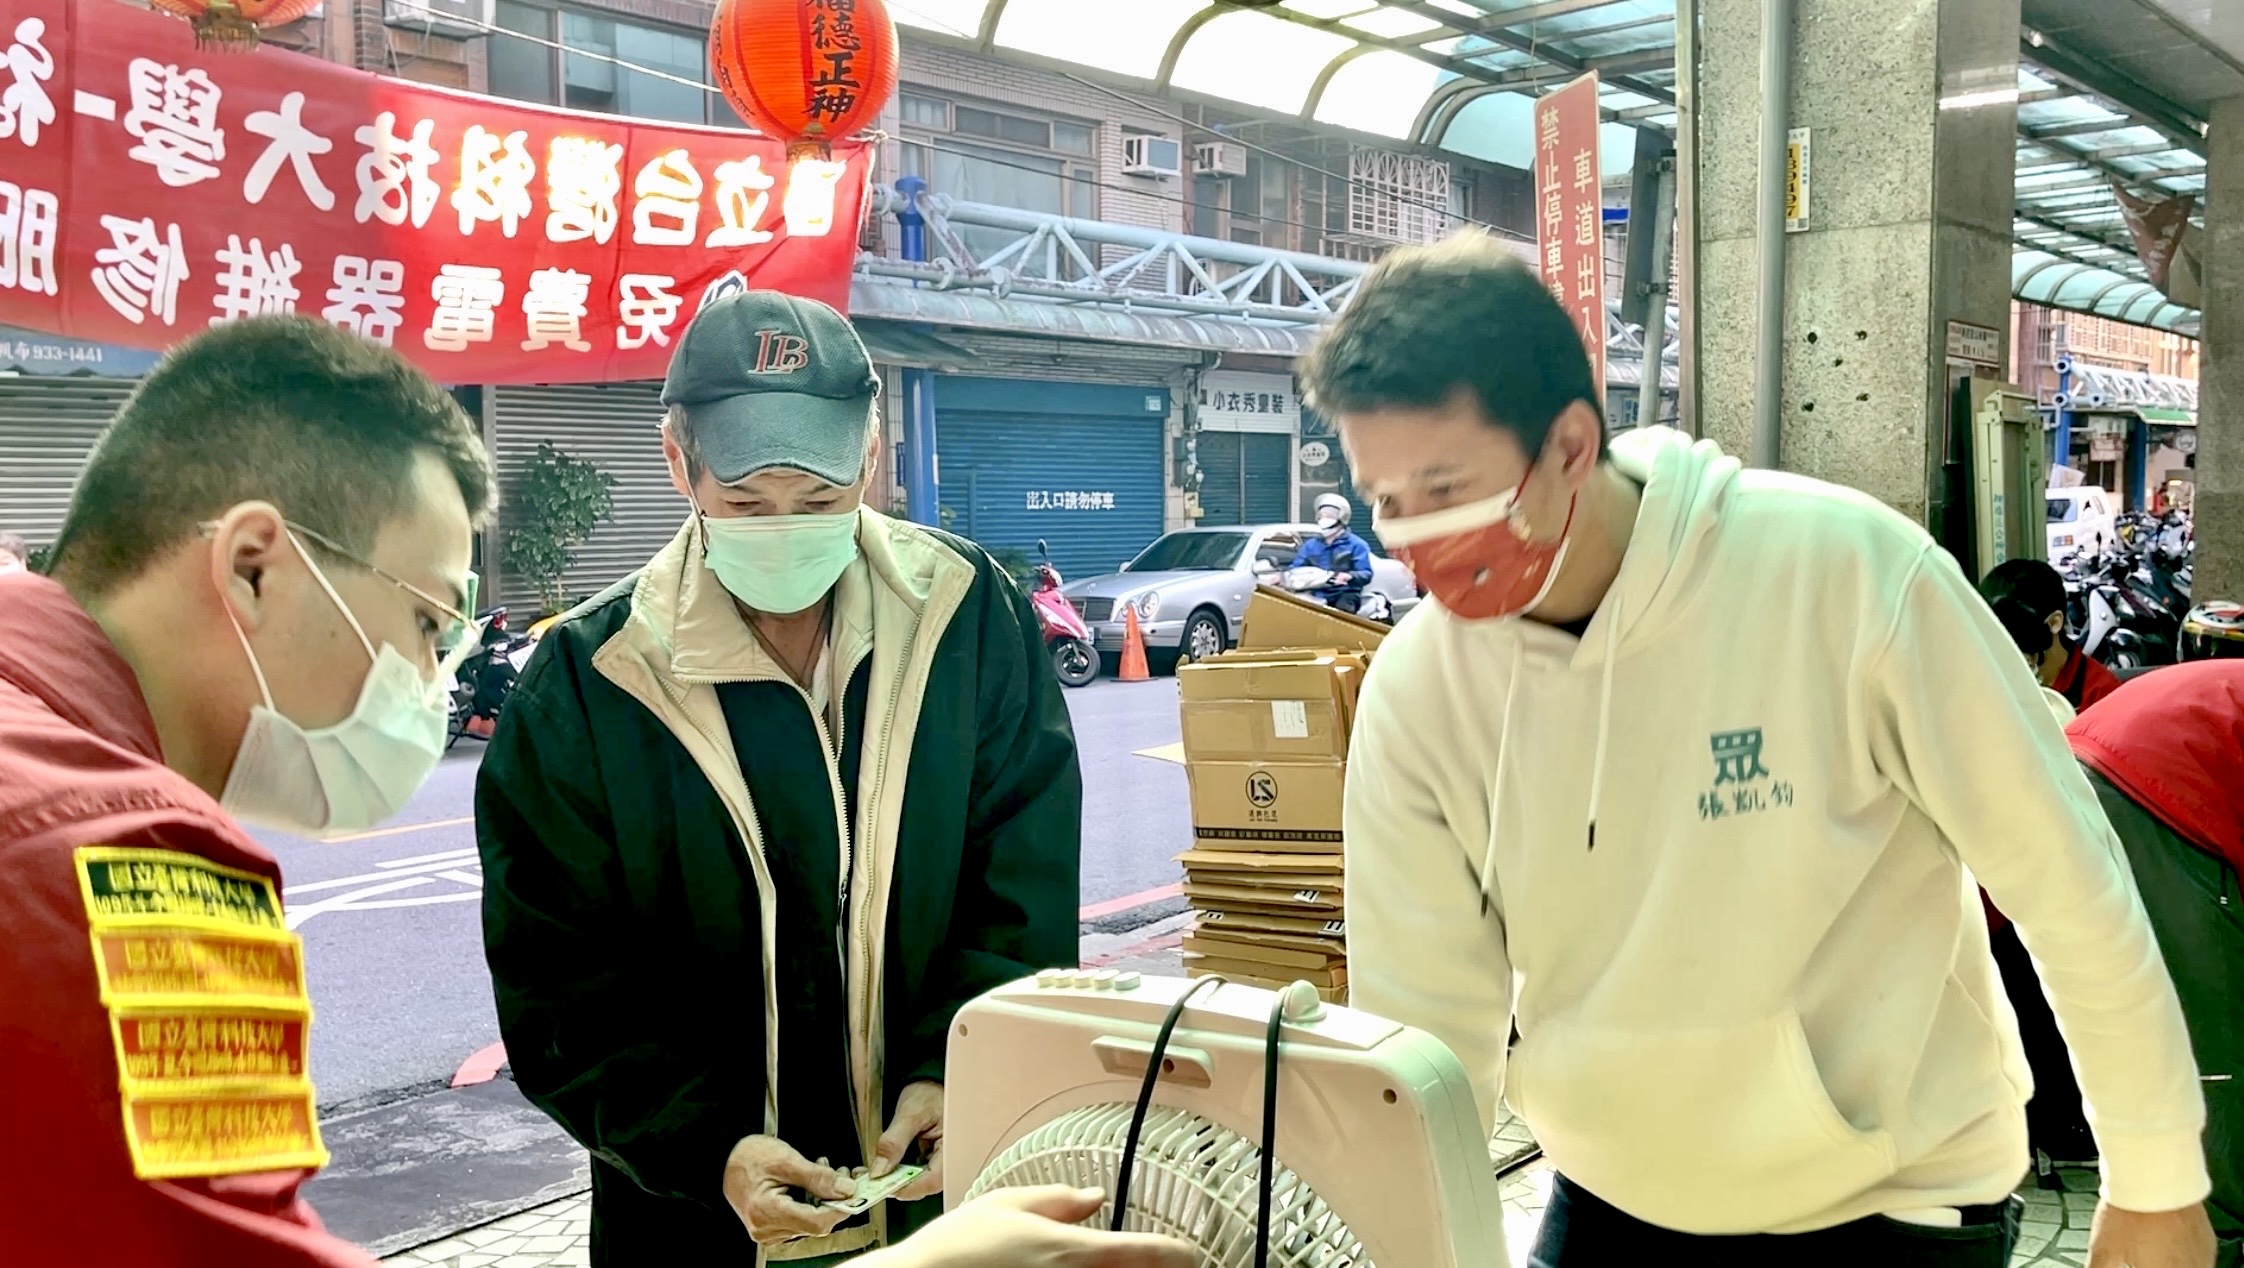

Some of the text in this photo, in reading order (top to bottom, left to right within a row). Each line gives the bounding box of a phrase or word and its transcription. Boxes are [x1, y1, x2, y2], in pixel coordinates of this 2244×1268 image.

[1026, 491, 1116, 511] 出入口請勿停車
